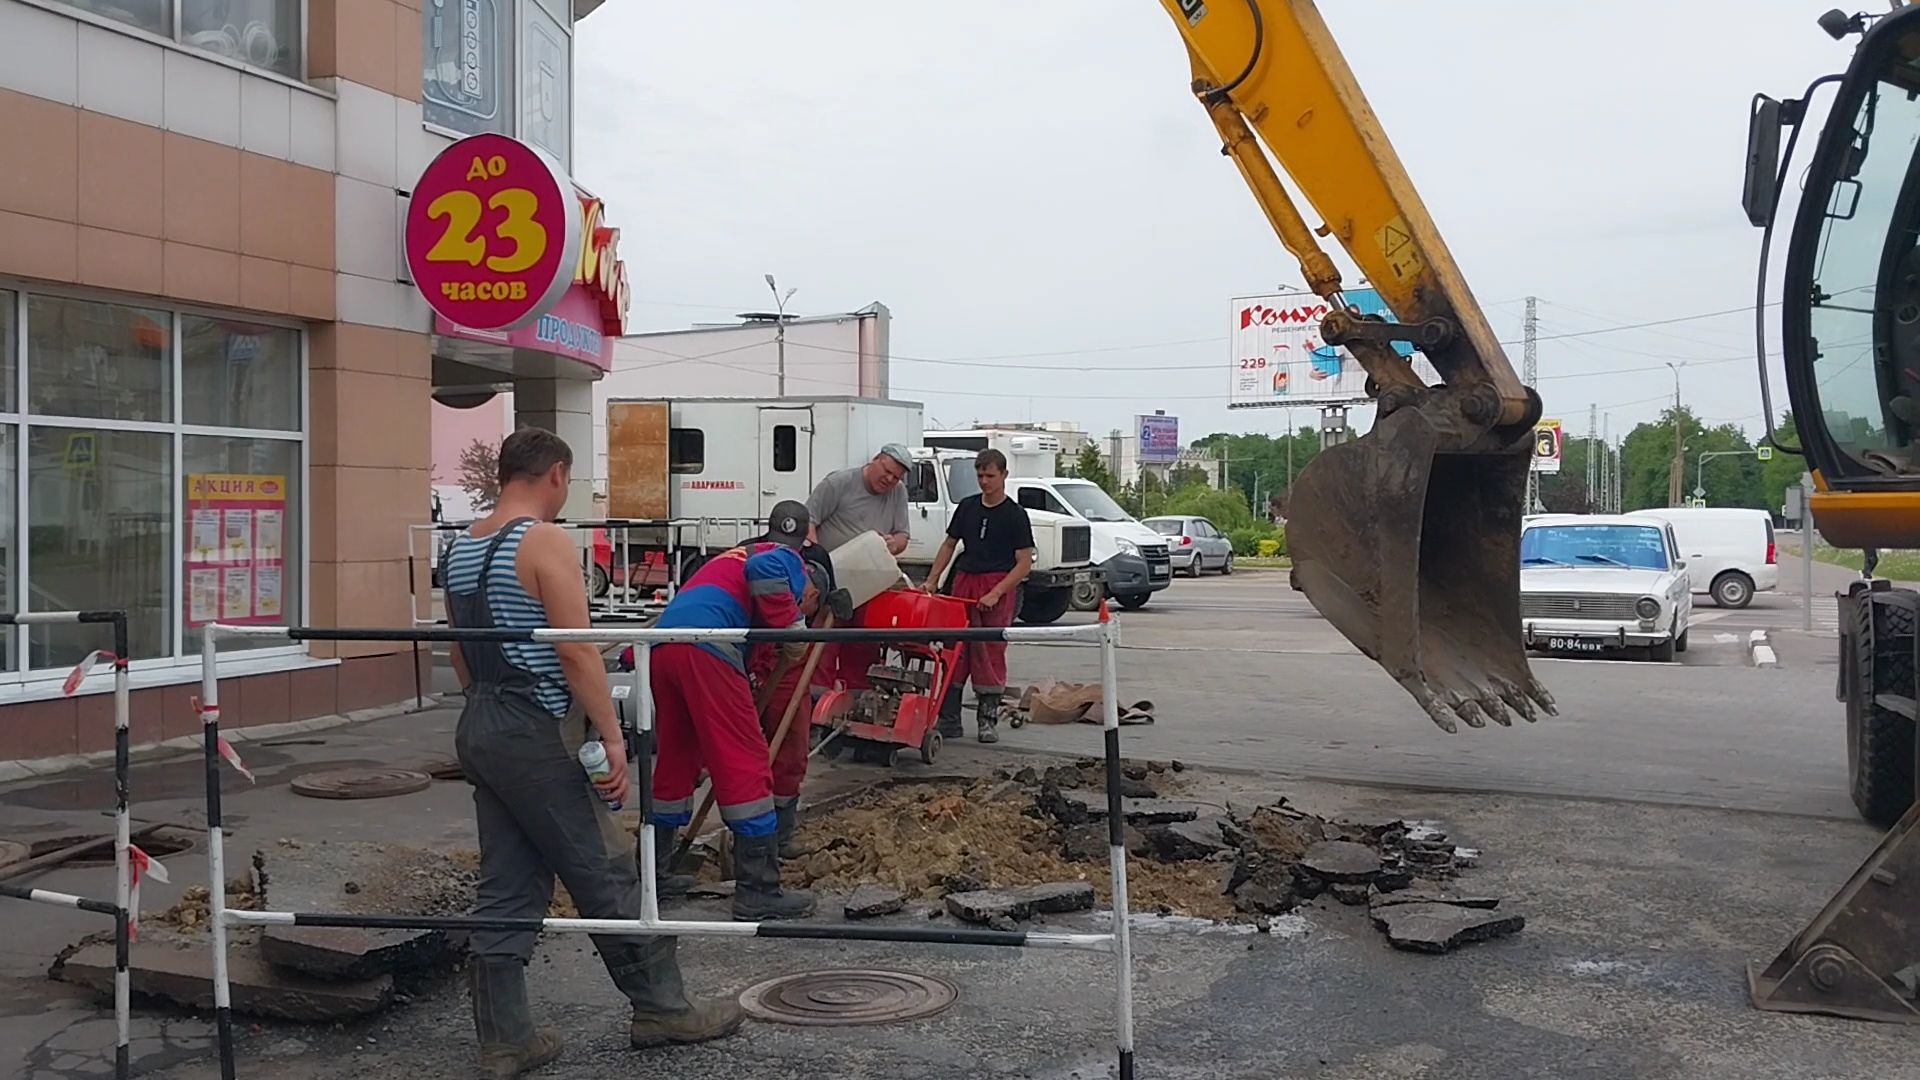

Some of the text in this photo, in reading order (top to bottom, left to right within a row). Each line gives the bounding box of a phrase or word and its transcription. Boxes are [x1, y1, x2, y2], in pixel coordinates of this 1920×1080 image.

[426, 188, 547, 272] 23
[440, 281, 528, 301] часов
[1240, 357, 1266, 369] 229
[194, 479, 255, 494] АКЦИЯ
